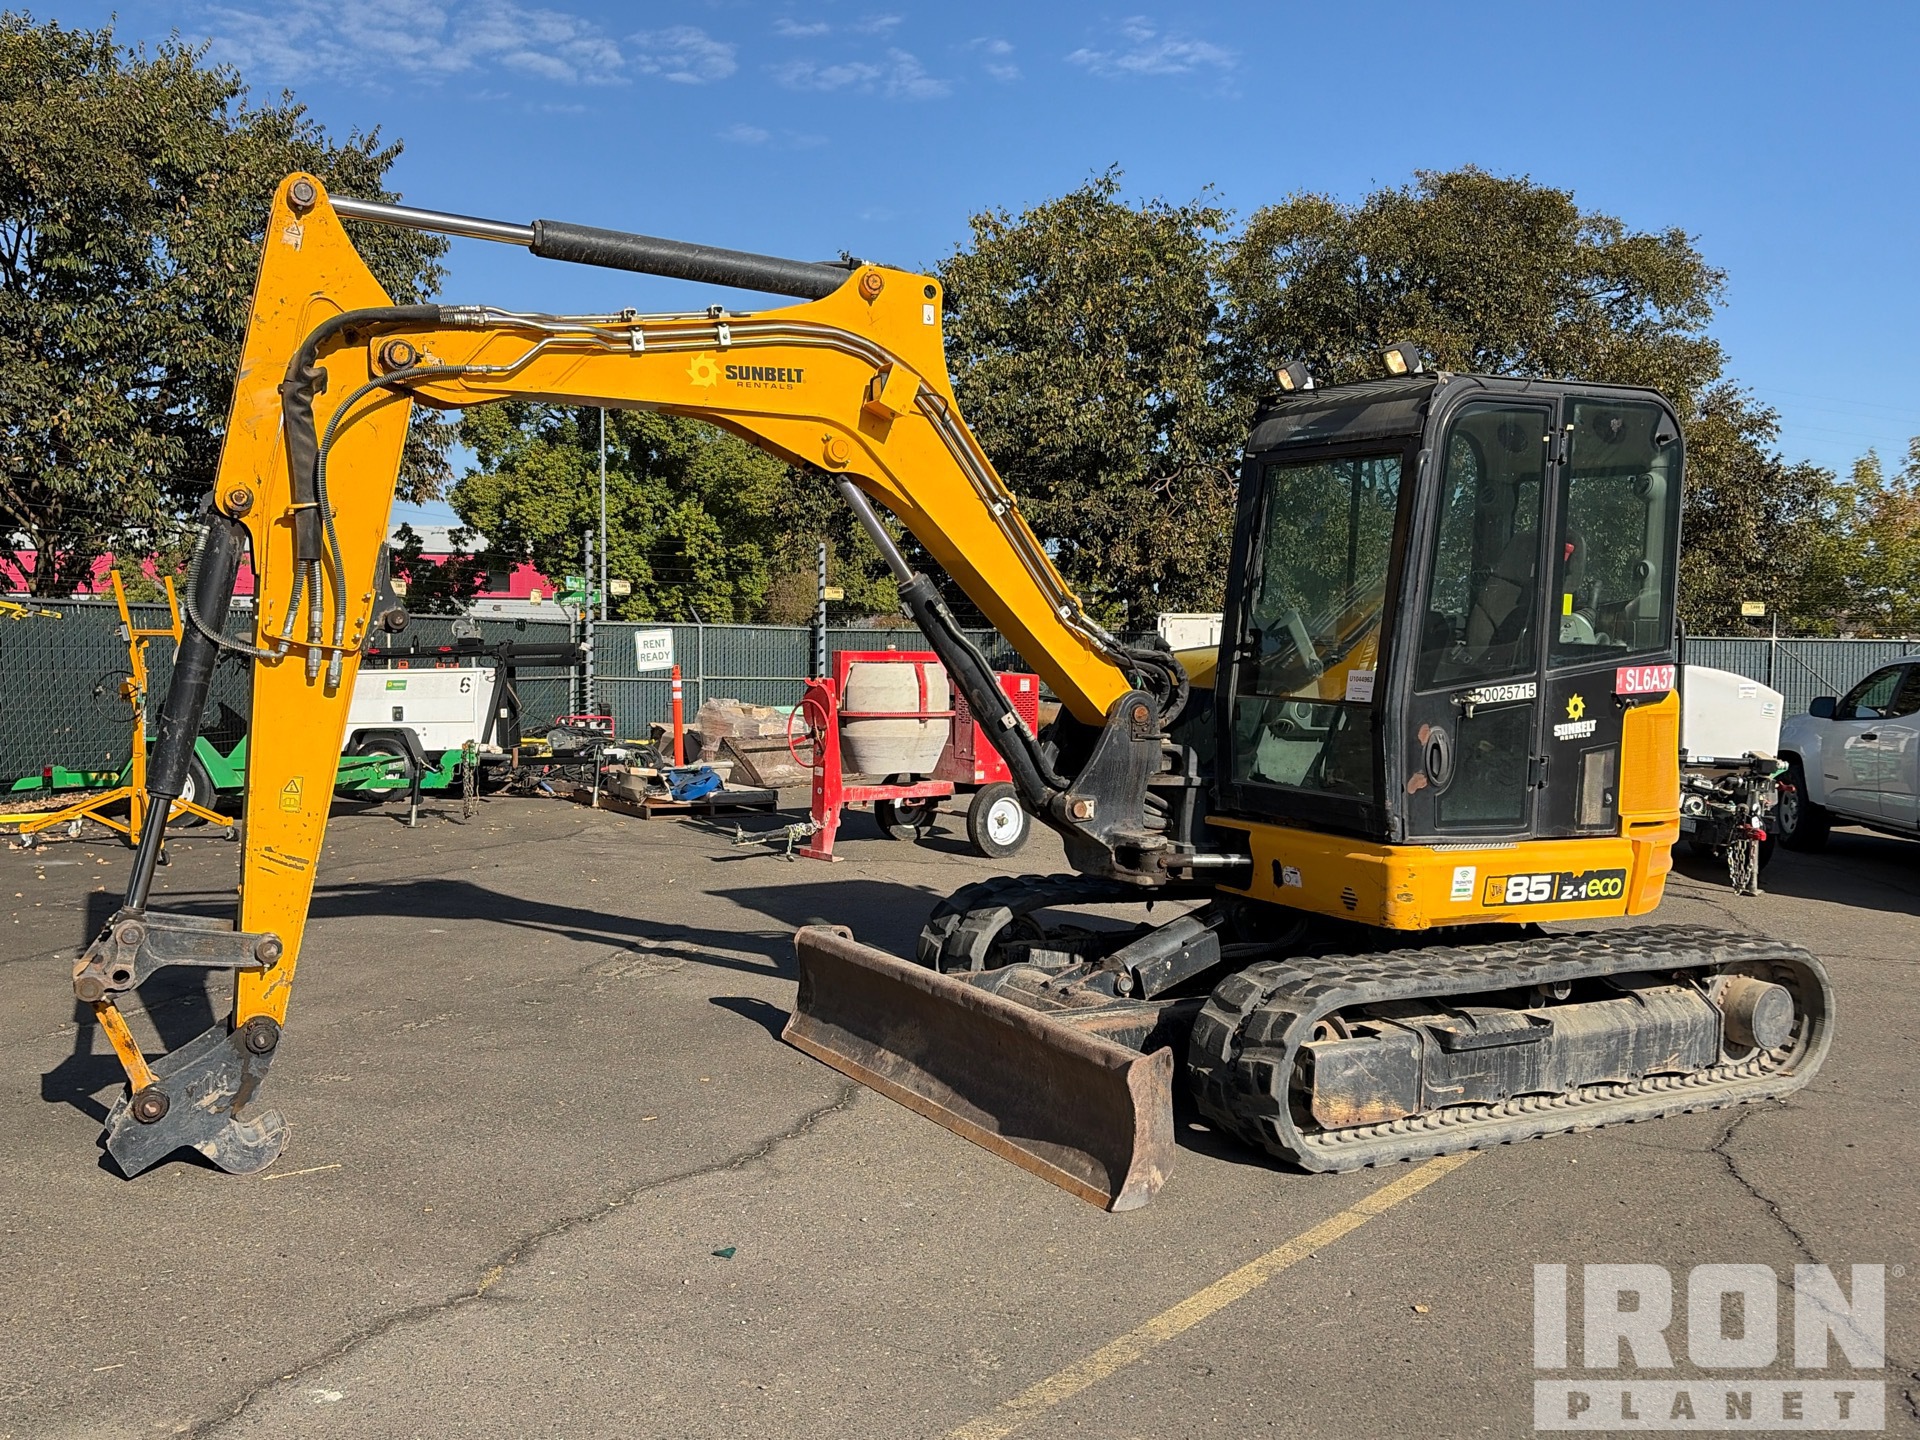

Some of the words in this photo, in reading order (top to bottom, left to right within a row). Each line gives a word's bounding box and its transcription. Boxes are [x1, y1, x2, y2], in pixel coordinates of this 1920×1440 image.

[725, 365, 804, 383] SUNBELT
[736, 381, 794, 390] RENTALS
[643, 639, 666, 649] RENT
[640, 651, 671, 662] READY
[460, 677, 471, 693] 6
[1625, 667, 1676, 692] SL6A37
[1553, 720, 1597, 737] SUNBELT
[1559, 732, 1591, 741] RENTALS
[1505, 875, 1552, 903] 85
